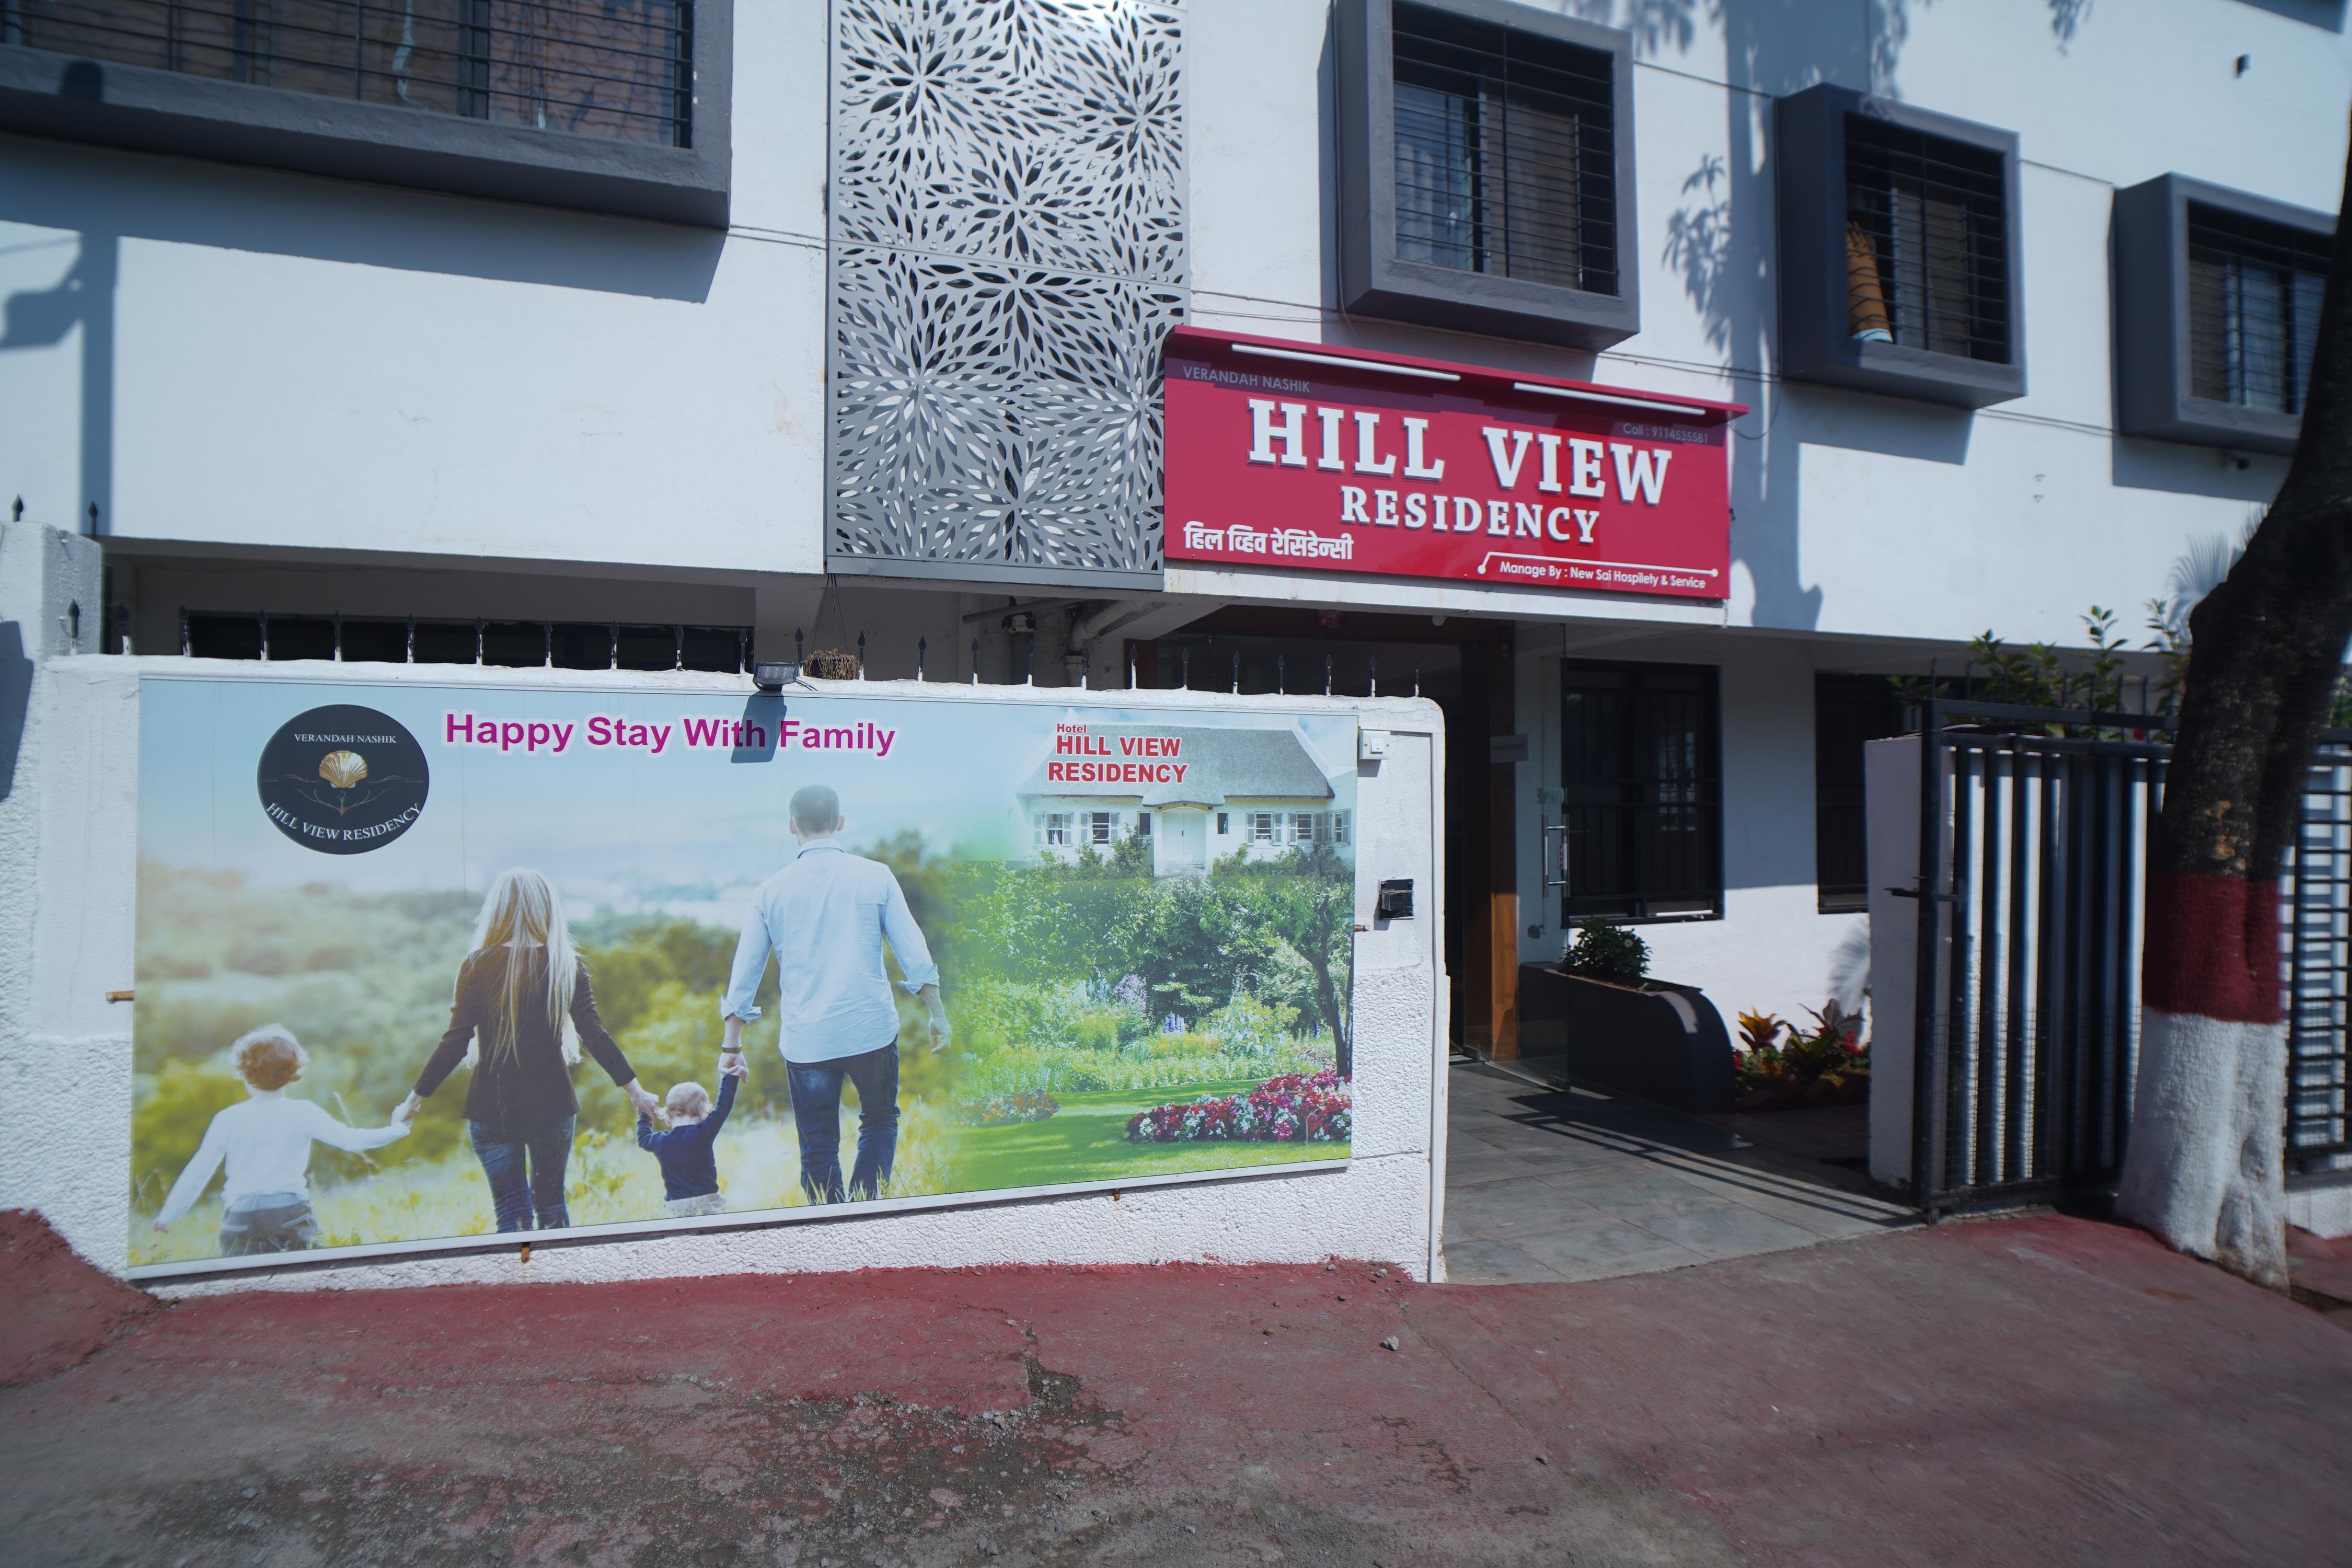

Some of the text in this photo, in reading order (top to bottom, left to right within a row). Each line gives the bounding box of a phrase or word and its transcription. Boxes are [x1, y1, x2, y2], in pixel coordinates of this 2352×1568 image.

[1183, 366, 1310, 392] VERANDAH NASHIK
[1623, 423, 1643, 435] Call
[1653, 426, 1708, 443] 9114535581
[1248, 398, 1672, 505] HILL VIEW
[1341, 486, 1599, 544] RESIDENCY
[1183, 521, 1224, 550] हिल
[1270, 527, 1354, 559] रेसिडेन्सी
[1500, 561, 1547, 578] Manage
[1549, 565, 1562, 579] By
[1570, 567, 1594, 579] New
[1596, 569, 1611, 581] Sai
[1661, 575, 1668, 585] &
[1670, 575, 1706, 589] Service
[294, 733, 396, 744] VERANDAH NASHIK
[447, 714, 895, 757] Happy Stay With Family
[1057, 724, 1086, 733] Hotel
[1057, 735, 1181, 756] HILL VIEW
[1048, 762, 1187, 783] RESIDENCY
[266, 803, 420, 840] HILL VIEW RESIDENCY
